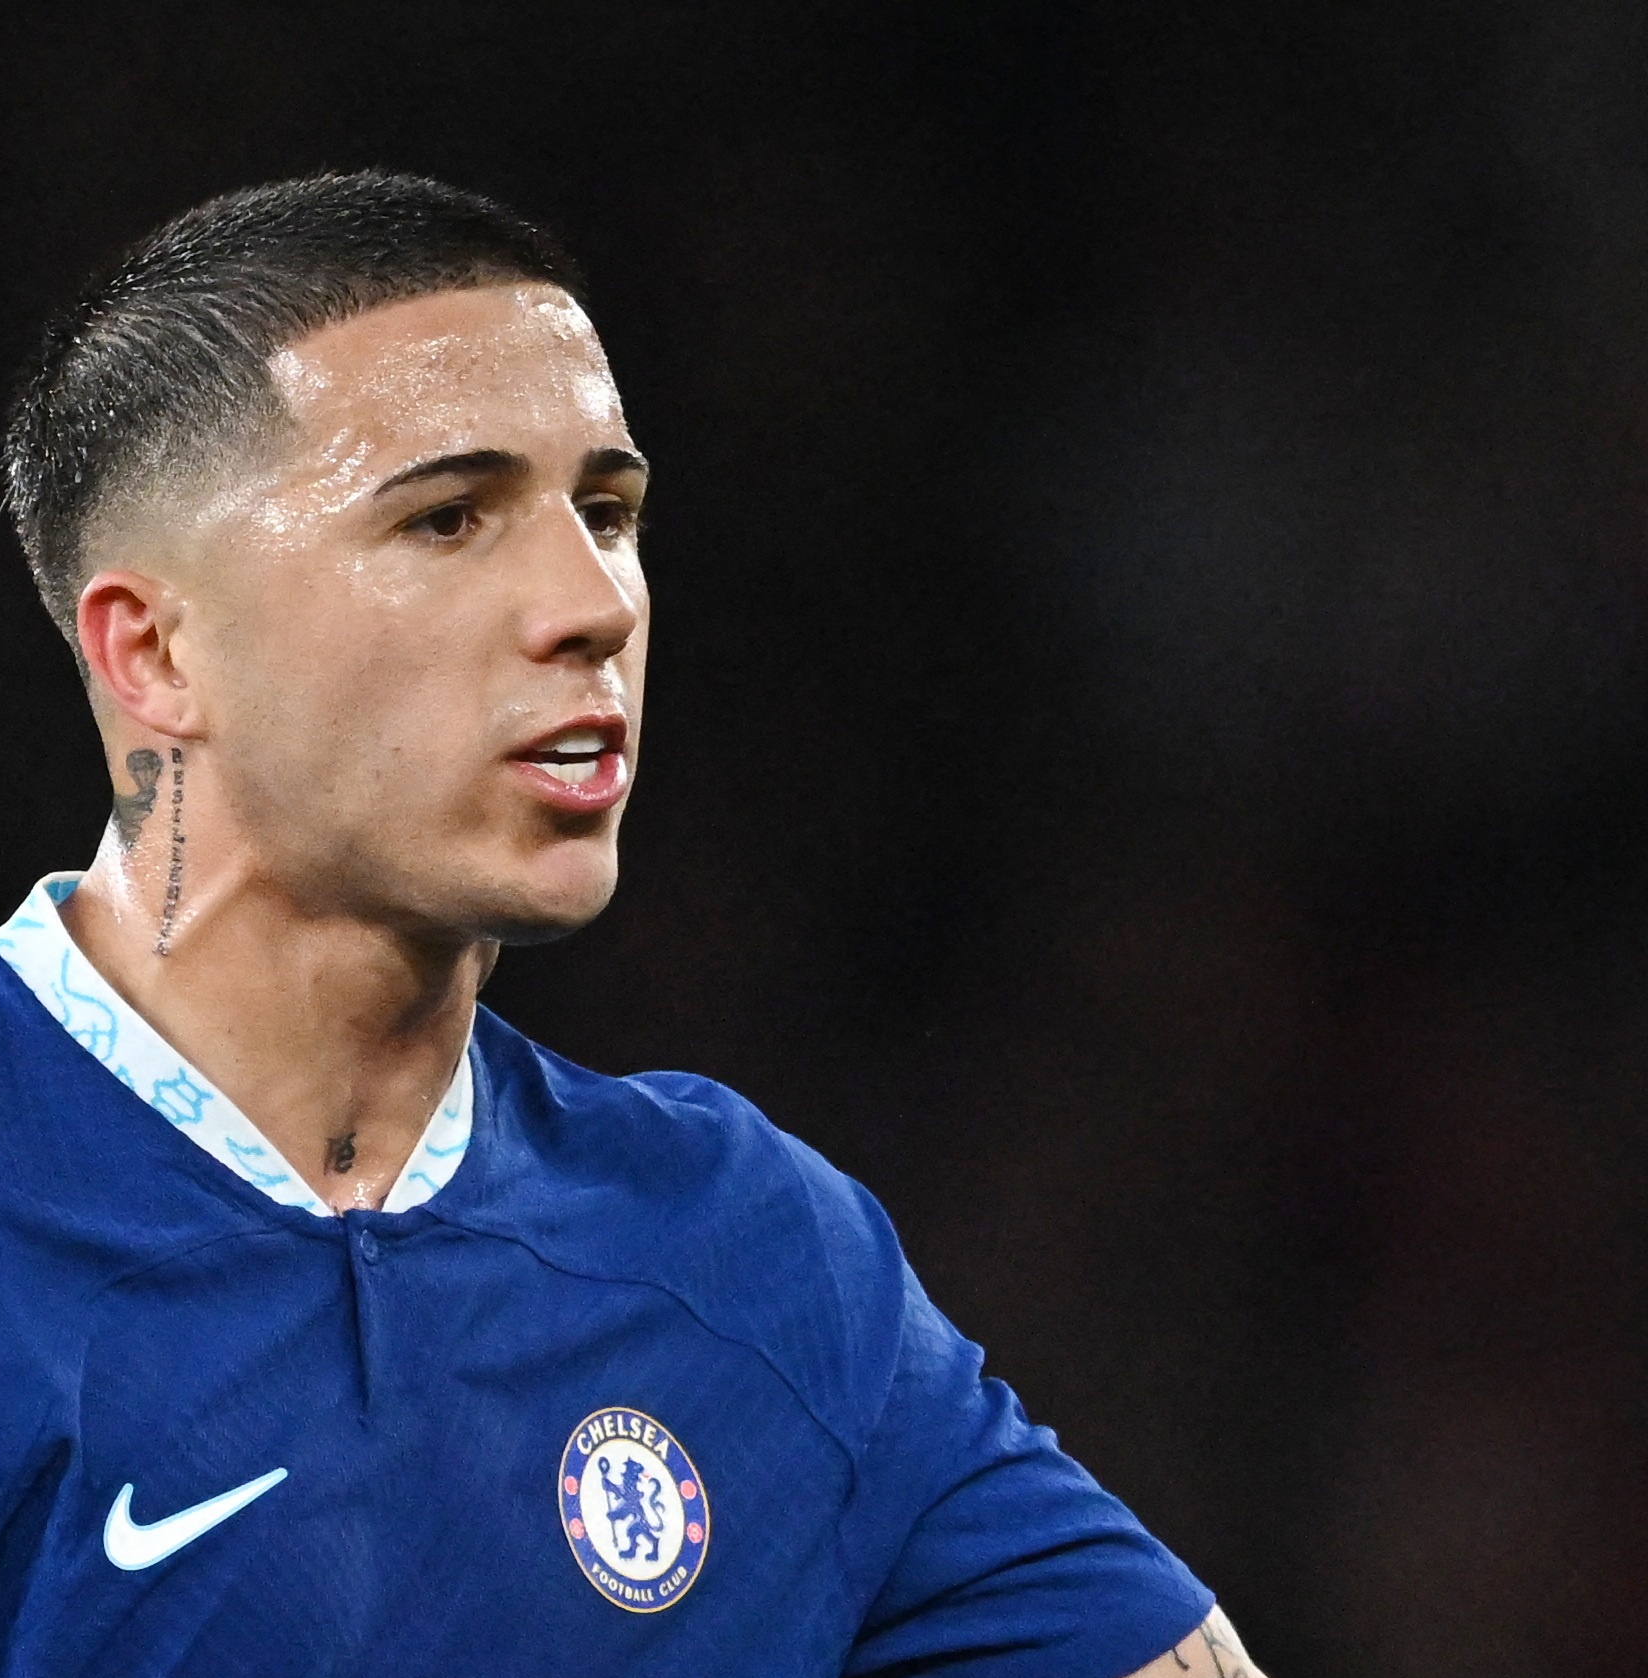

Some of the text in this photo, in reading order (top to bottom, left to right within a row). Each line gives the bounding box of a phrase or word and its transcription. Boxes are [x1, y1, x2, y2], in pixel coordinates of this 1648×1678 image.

[577, 1414, 670, 1460] CHELSEA
[591, 1562, 688, 1602] FOOTBALL CLUB
